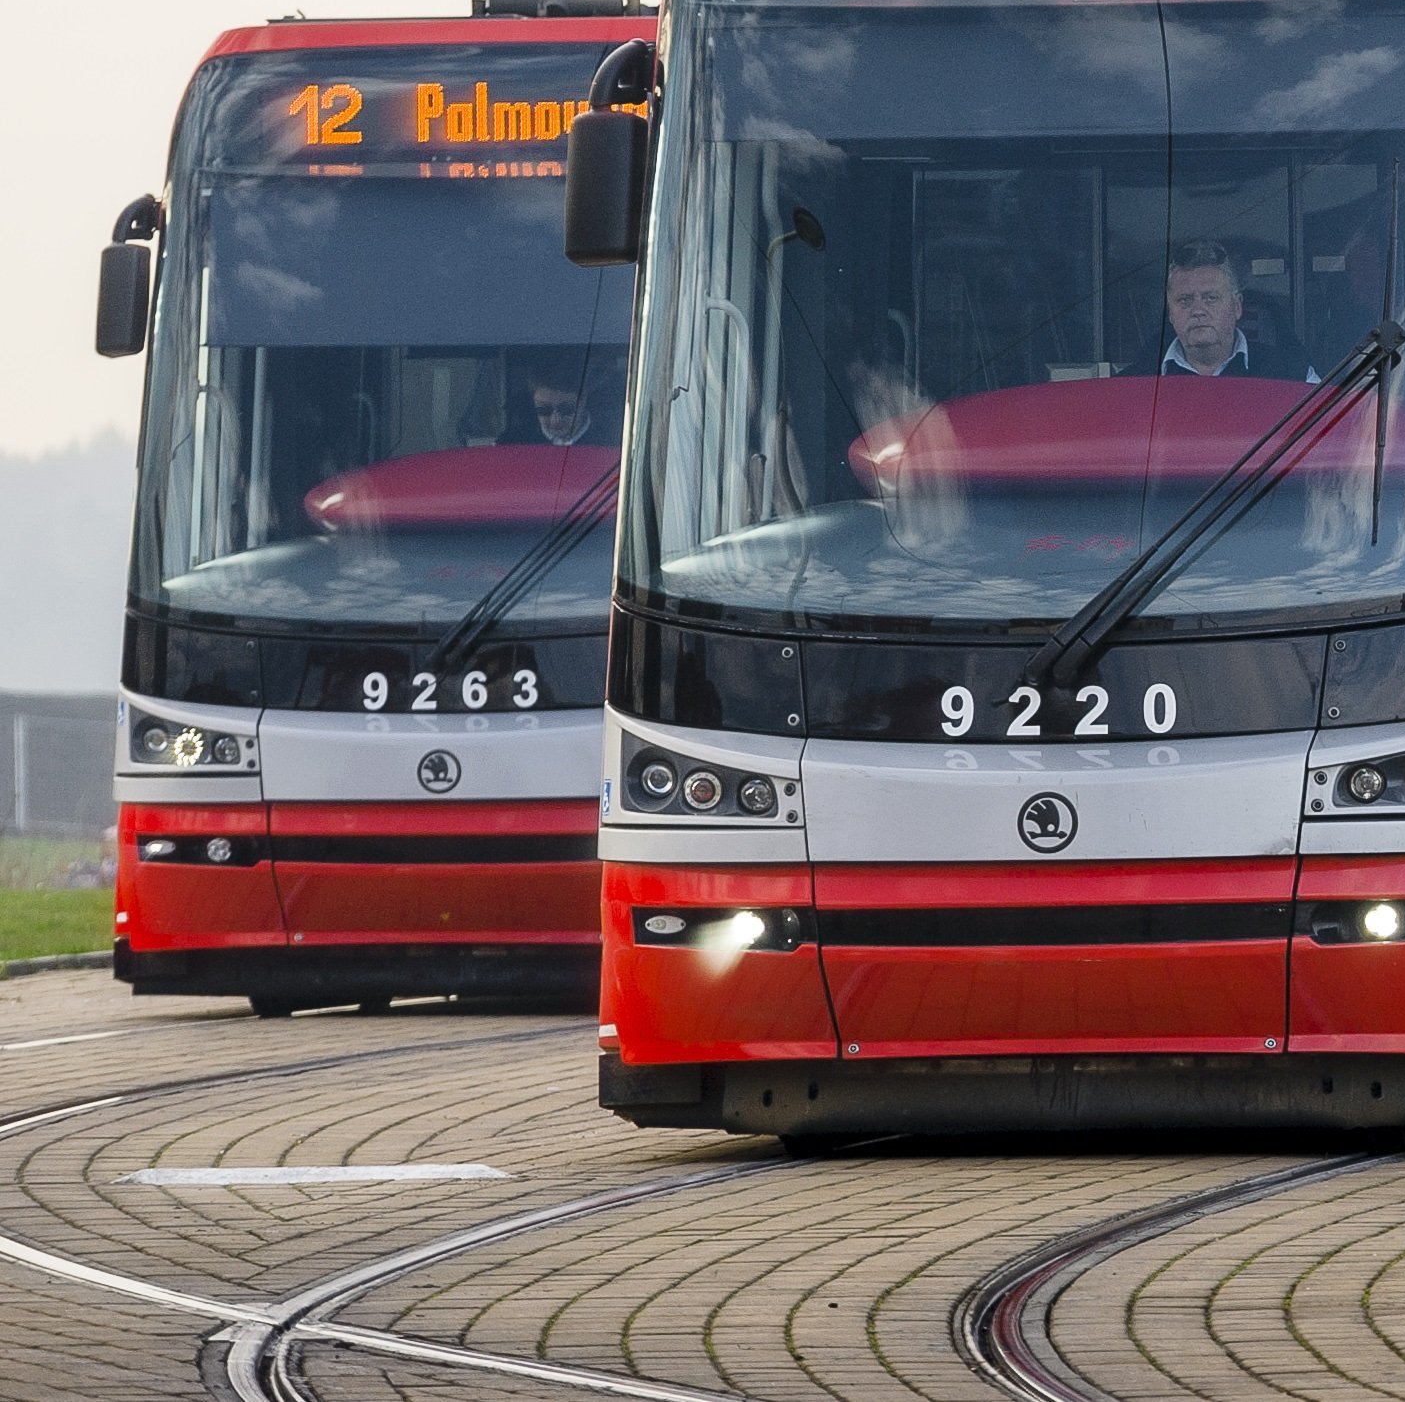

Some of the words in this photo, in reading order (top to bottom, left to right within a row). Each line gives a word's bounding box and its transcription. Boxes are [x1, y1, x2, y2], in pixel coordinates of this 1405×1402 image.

[289, 83, 364, 145] 12
[362, 669, 539, 711] 9263
[940, 683, 1177, 737] 9220
